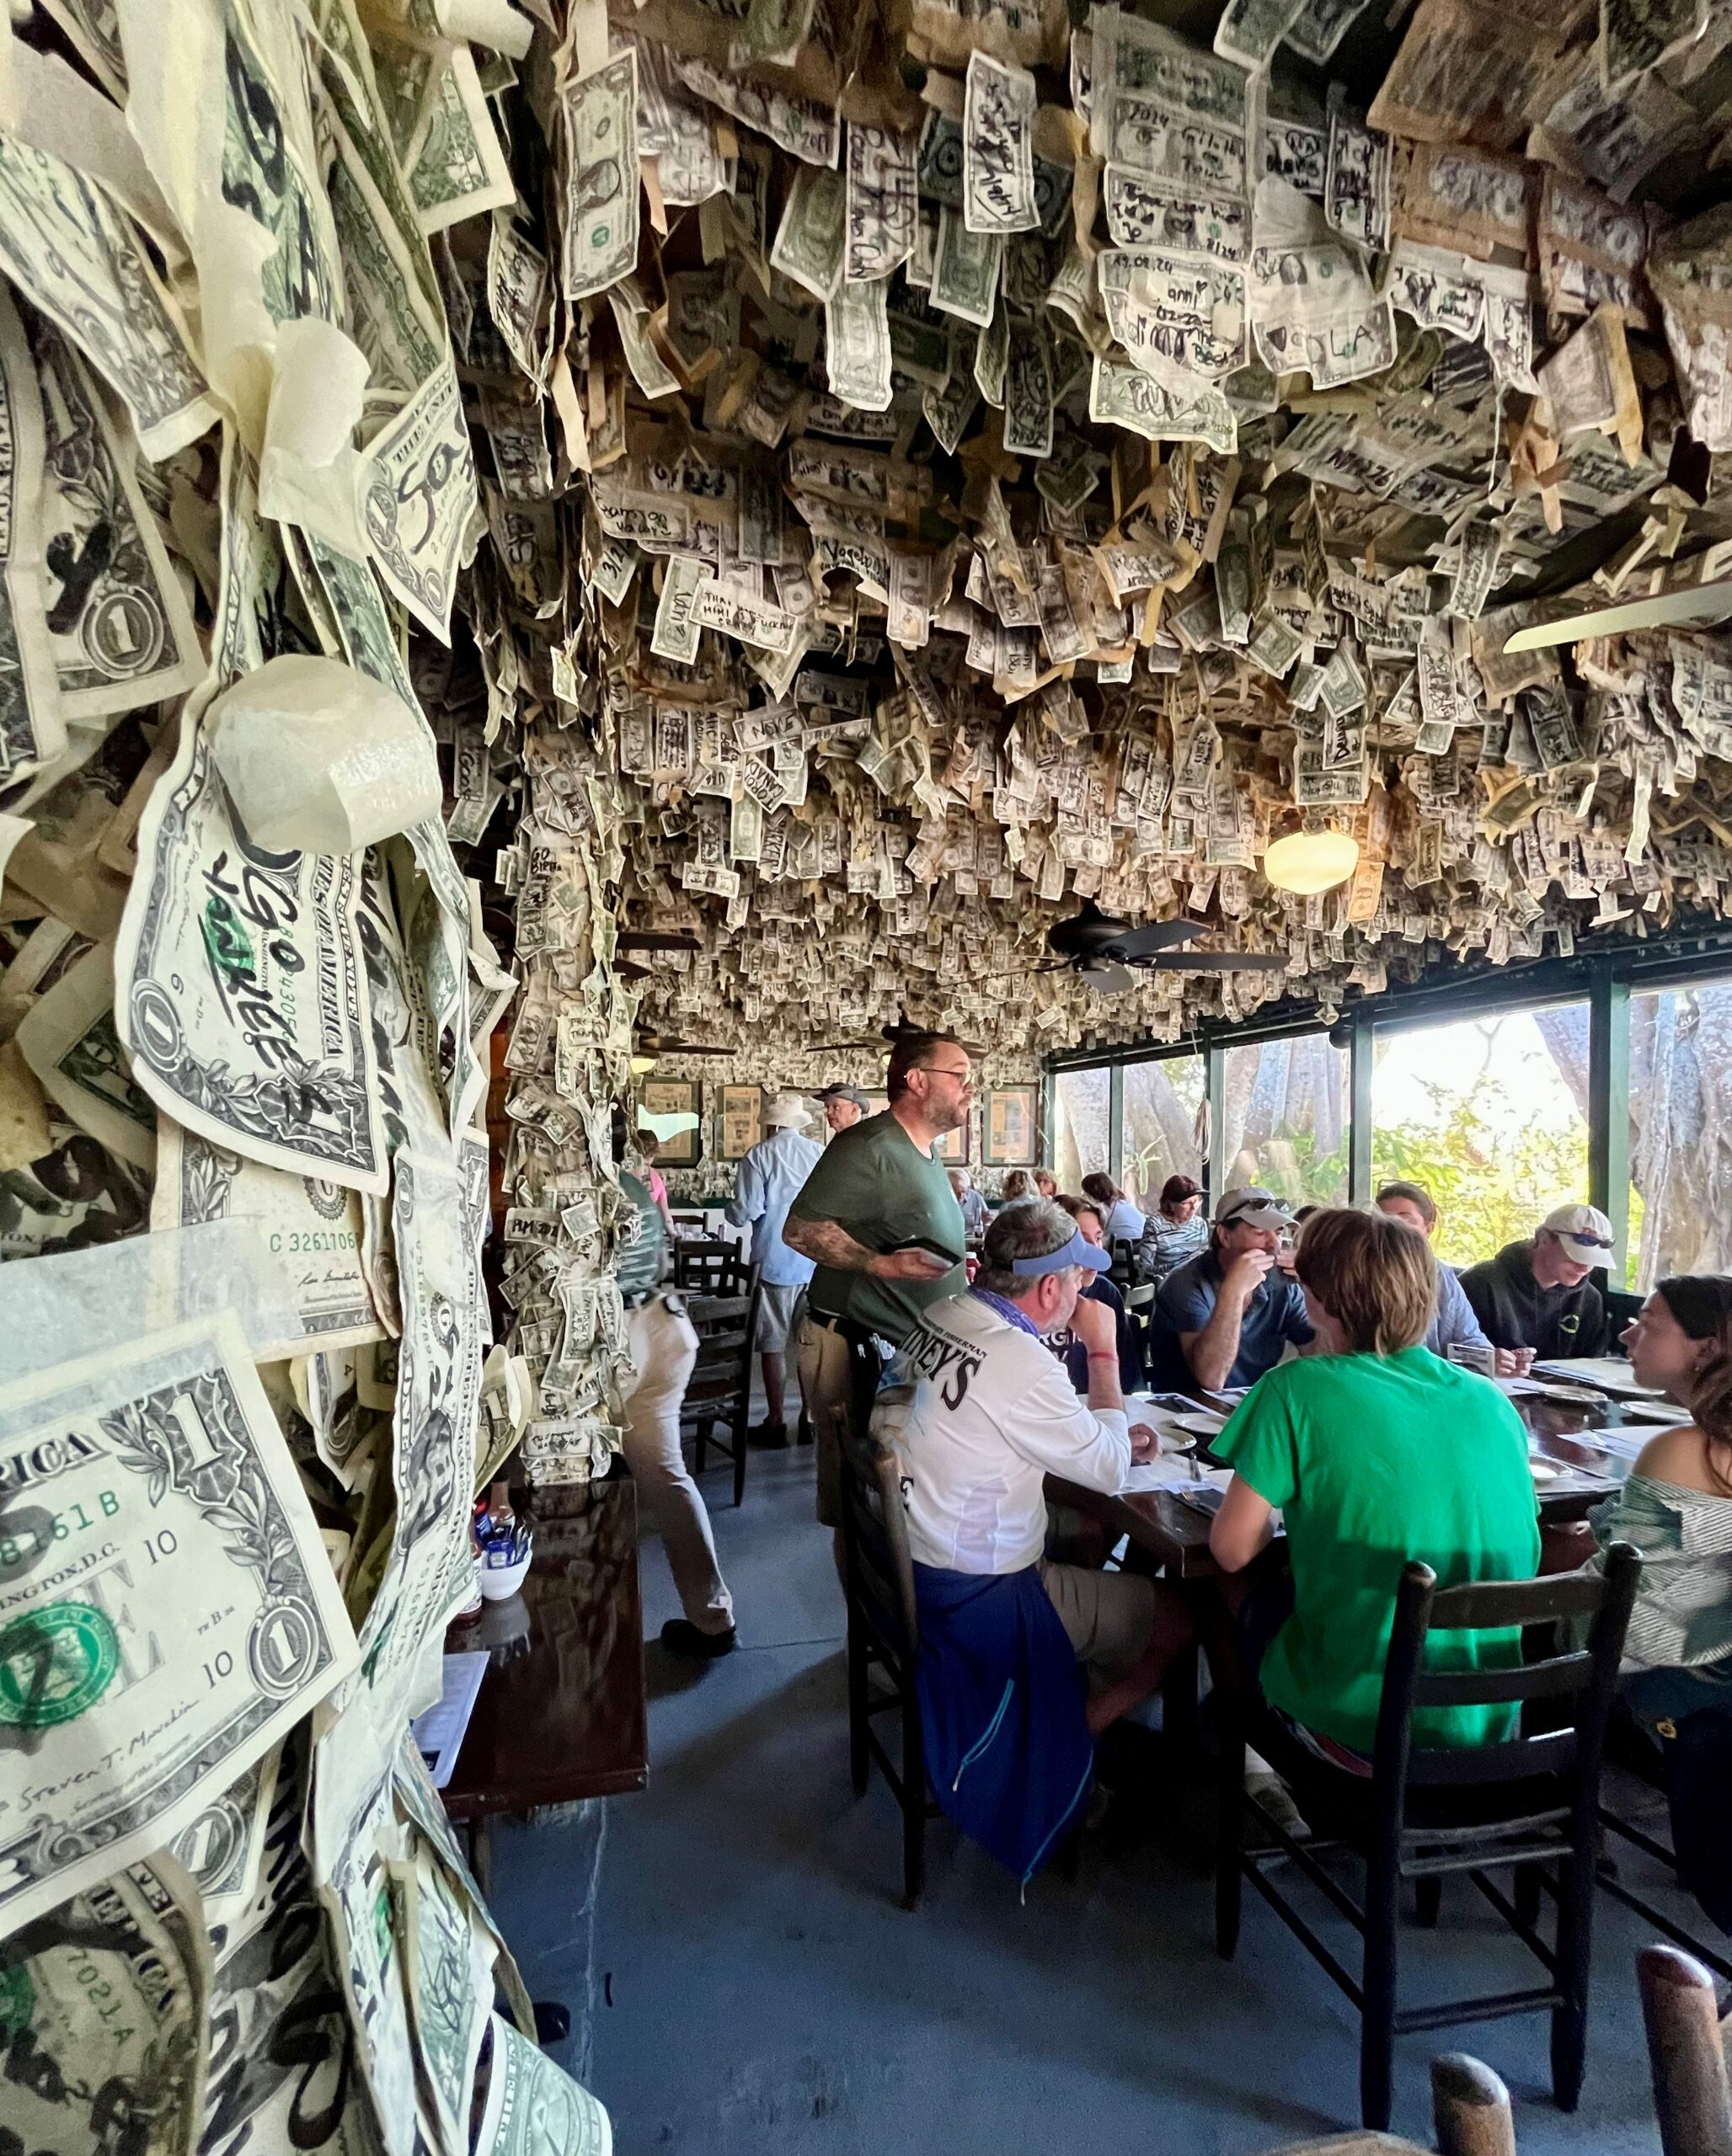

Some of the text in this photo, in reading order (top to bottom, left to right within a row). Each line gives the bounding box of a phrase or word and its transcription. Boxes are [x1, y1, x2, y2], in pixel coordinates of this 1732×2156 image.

[316, 938, 345, 1059] AMERICA
[99, 1490, 120, 1518] B
[142, 1529, 179, 1567] 10
[202, 1650, 234, 1691] 10
